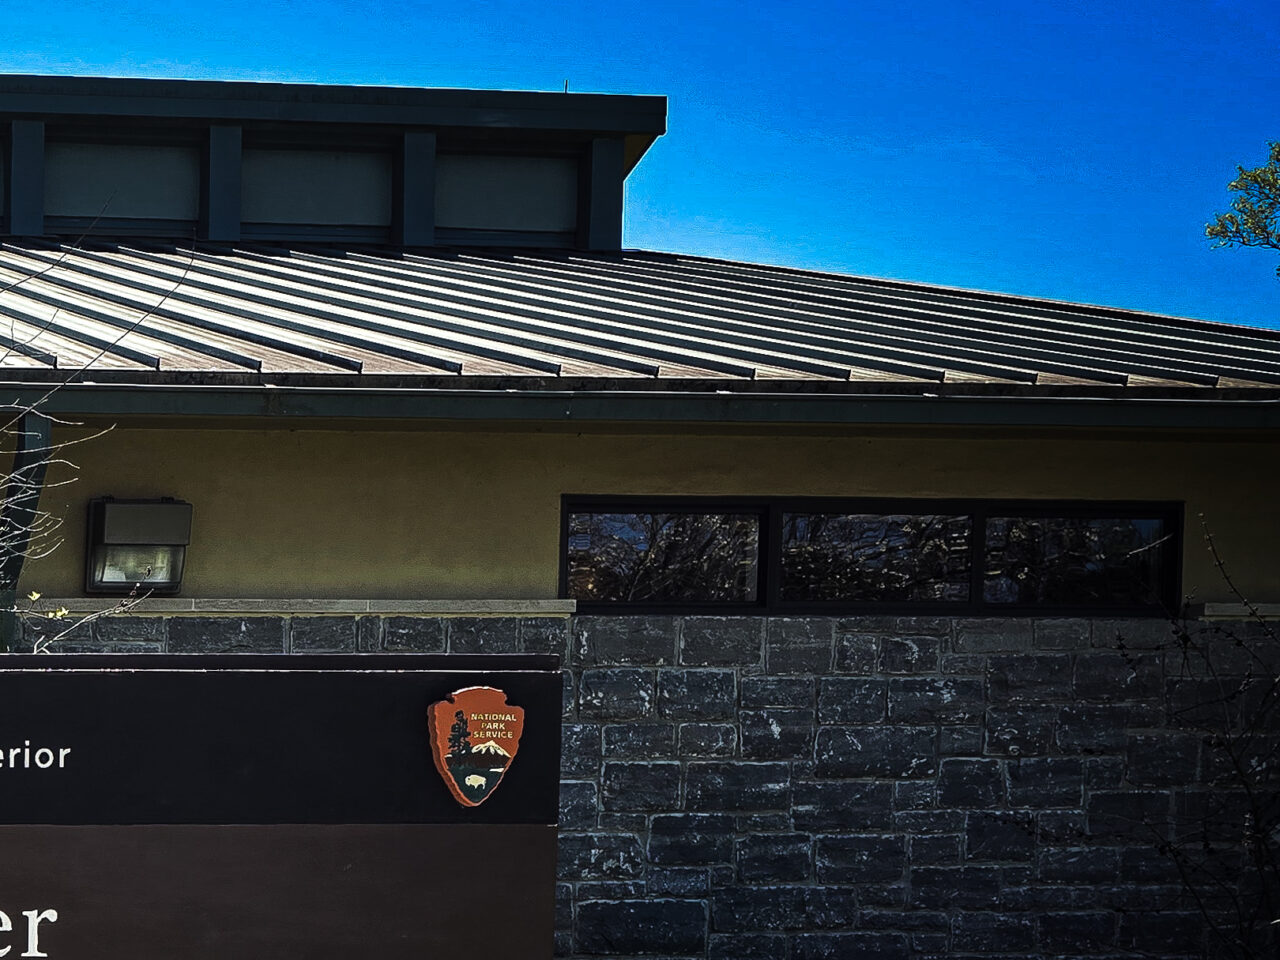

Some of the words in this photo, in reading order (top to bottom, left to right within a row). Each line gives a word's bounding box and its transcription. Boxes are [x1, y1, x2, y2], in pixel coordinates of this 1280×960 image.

[471, 713, 517, 722] NATIONAL
[481, 722, 505, 730] PARK
[473, 731, 513, 739] SERVICE
